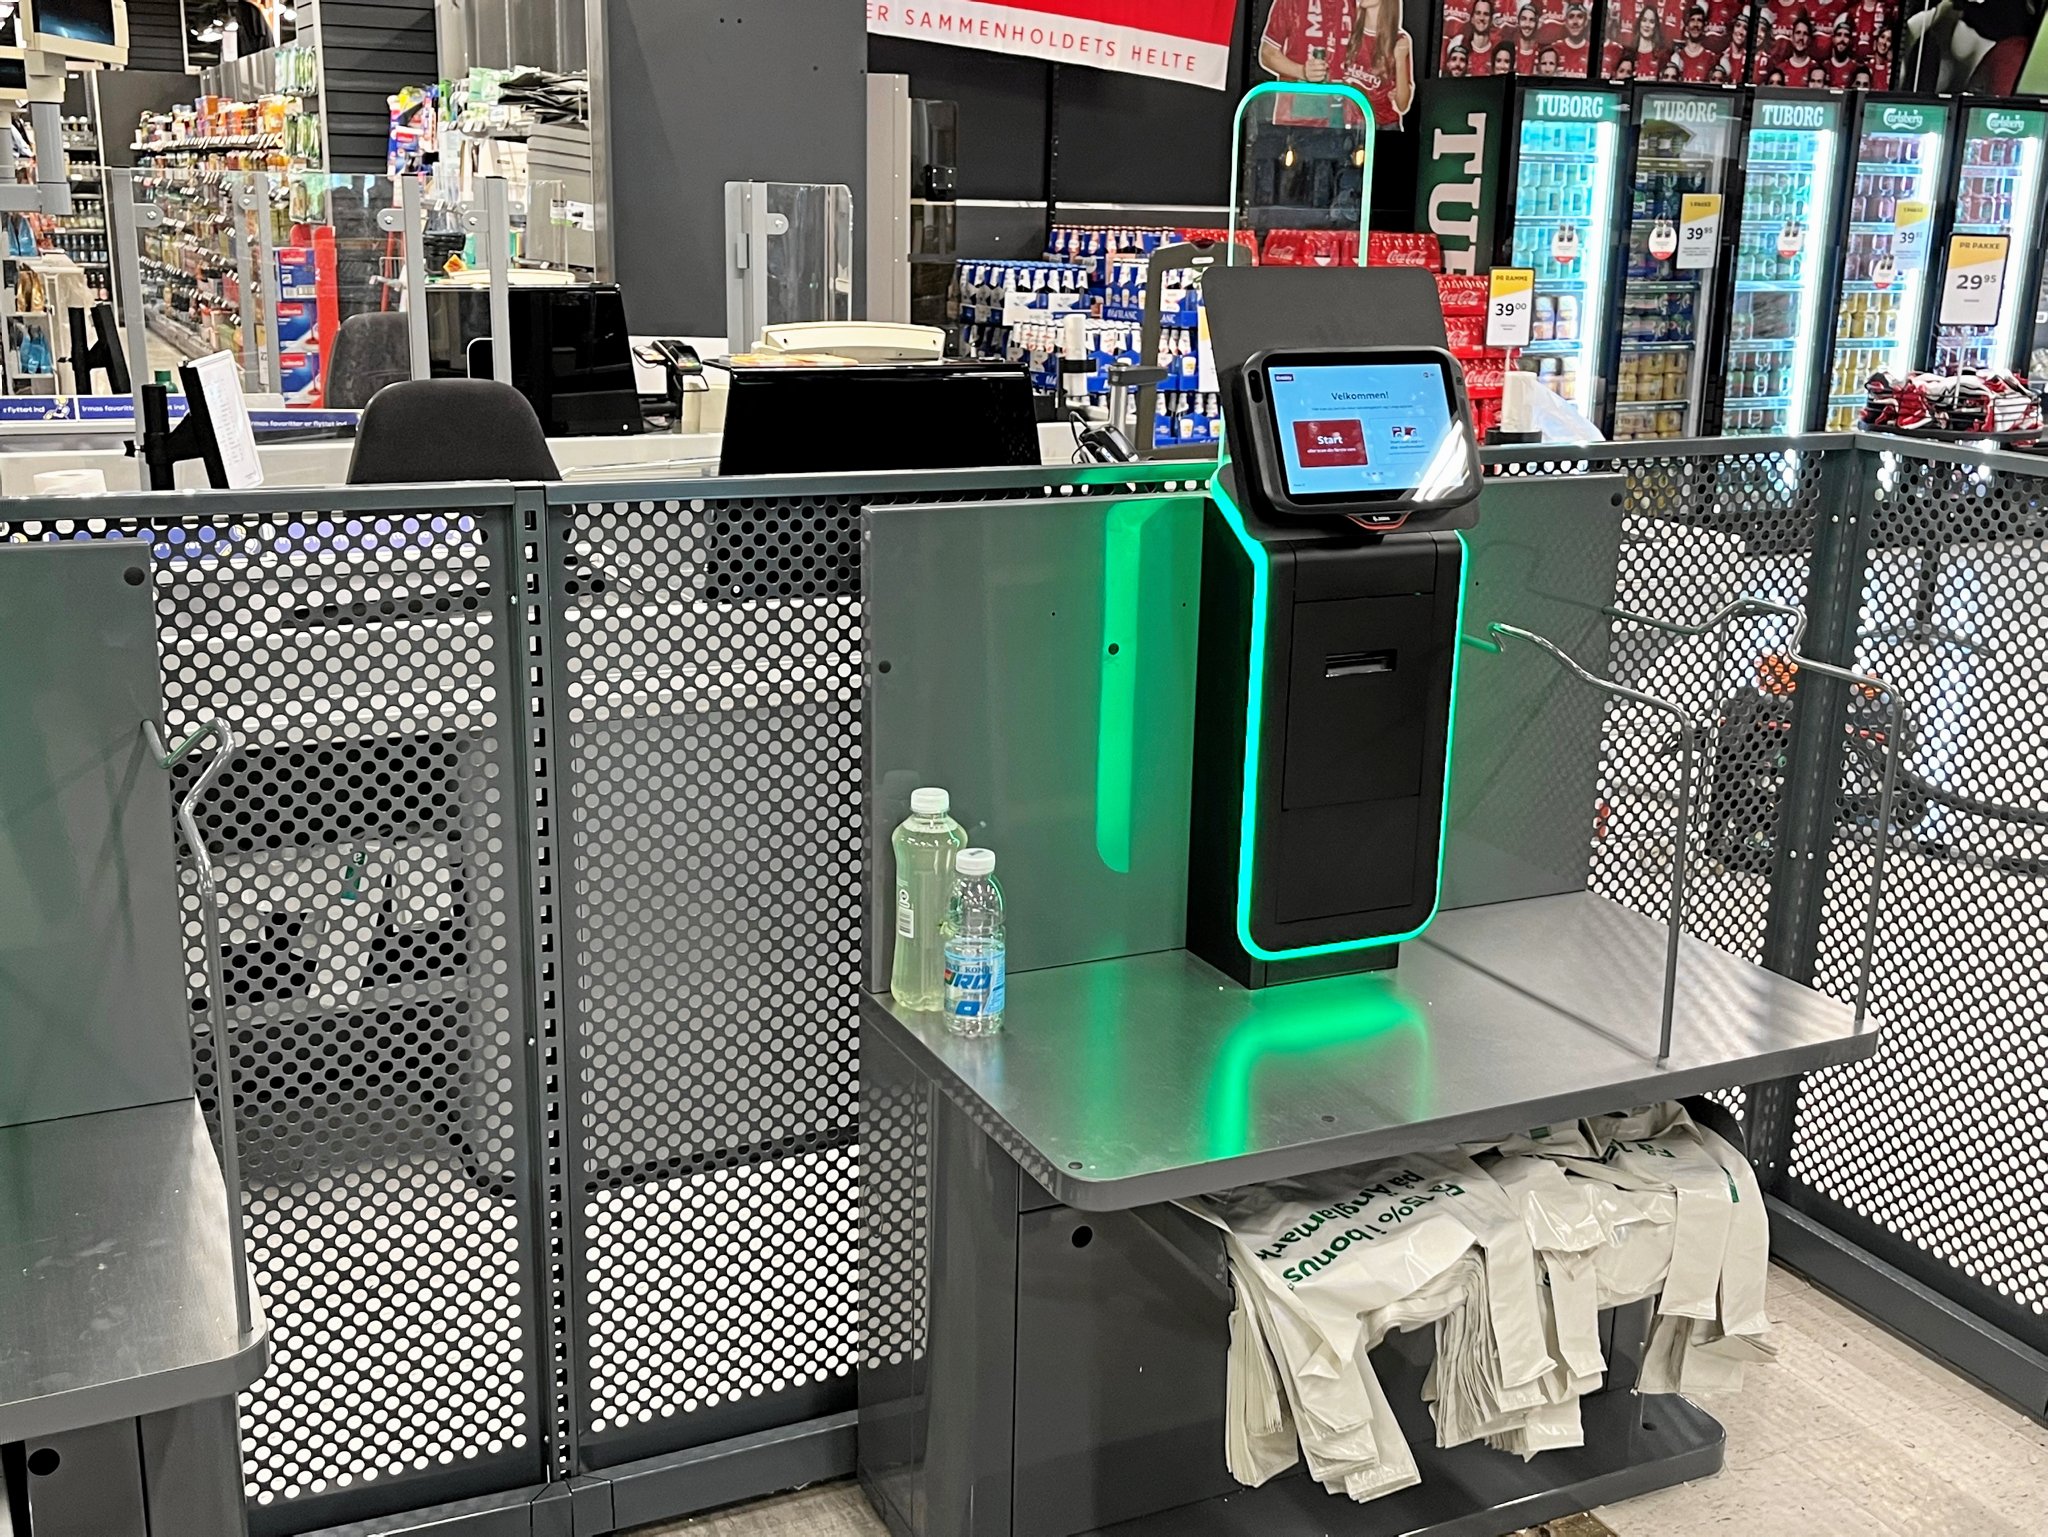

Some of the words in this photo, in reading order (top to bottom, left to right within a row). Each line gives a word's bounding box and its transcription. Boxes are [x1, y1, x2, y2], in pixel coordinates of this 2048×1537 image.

[905, 9, 1116, 57] SAMMENHOLDETS
[1132, 45, 1197, 72] HELTE
[1536, 93, 1604, 119] TUBORG
[1653, 99, 1717, 124] TUBORG
[1762, 104, 1824, 128] TUBORG
[1883, 107, 1923, 130] Carlsberg
[1986, 112, 2025, 135] Carlsberg
[1972, 242, 2000, 250] PAKKE
[1331, 391, 1389, 401] Velkommen!
[1317, 435, 1344, 445] Start
[1388, 1169, 1425, 1190] på
[1378, 1195, 1435, 1224] 15%
[1257, 1183, 1400, 1260] Änglamark
[1366, 1224, 1387, 1236] i
[1283, 1227, 1375, 1283] bonus
